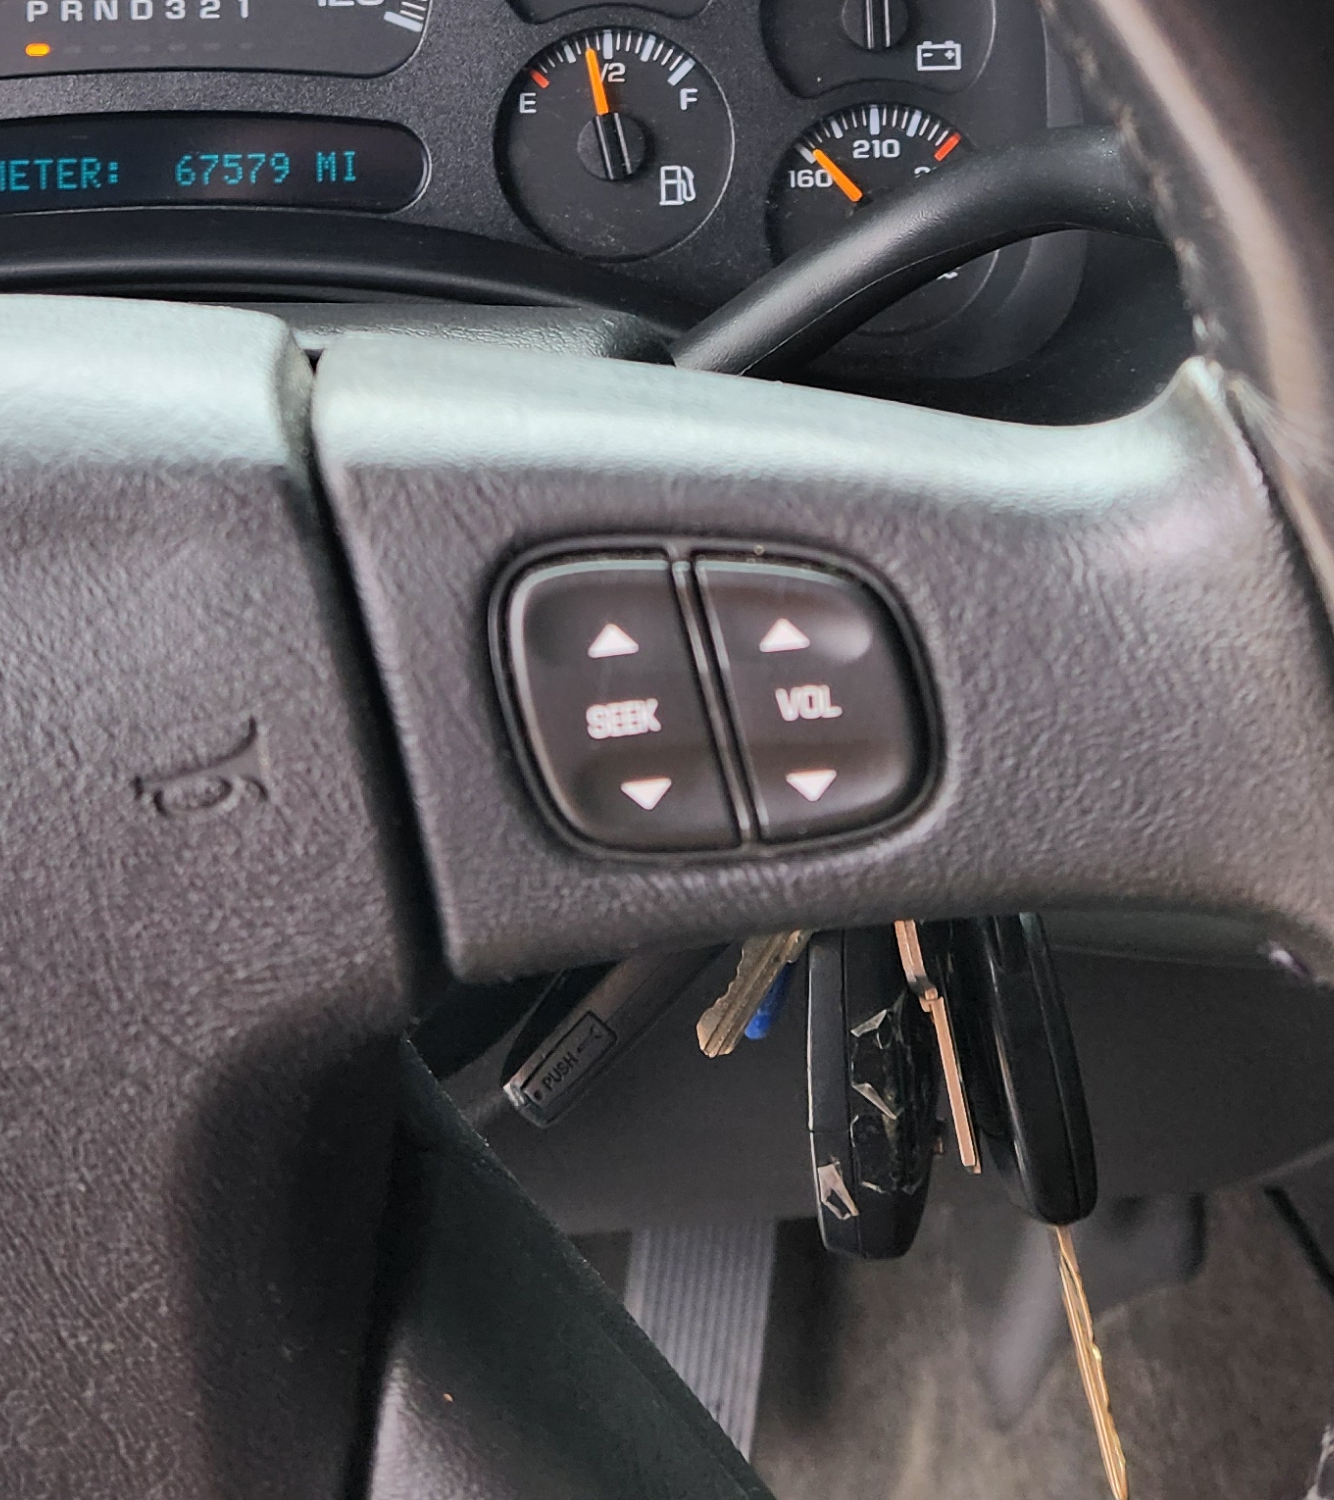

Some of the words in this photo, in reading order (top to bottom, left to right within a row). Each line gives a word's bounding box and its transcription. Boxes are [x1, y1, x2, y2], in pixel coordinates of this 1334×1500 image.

[27, 1, 48, 22] P
[61, 0, 82, 21] R
[95, 0, 118, 21] N
[520, 93, 536, 113] E
[680, 88, 698, 110] F
[853, 139, 900, 158] 210
[176, 152, 290, 186] 67579
[317, 152, 355, 182] MI
[789, 170, 834, 189] 160
[775, 685, 843, 721] VOL
[586, 698, 661, 739] SEEK
[542, 1052, 579, 1091] PUSH
